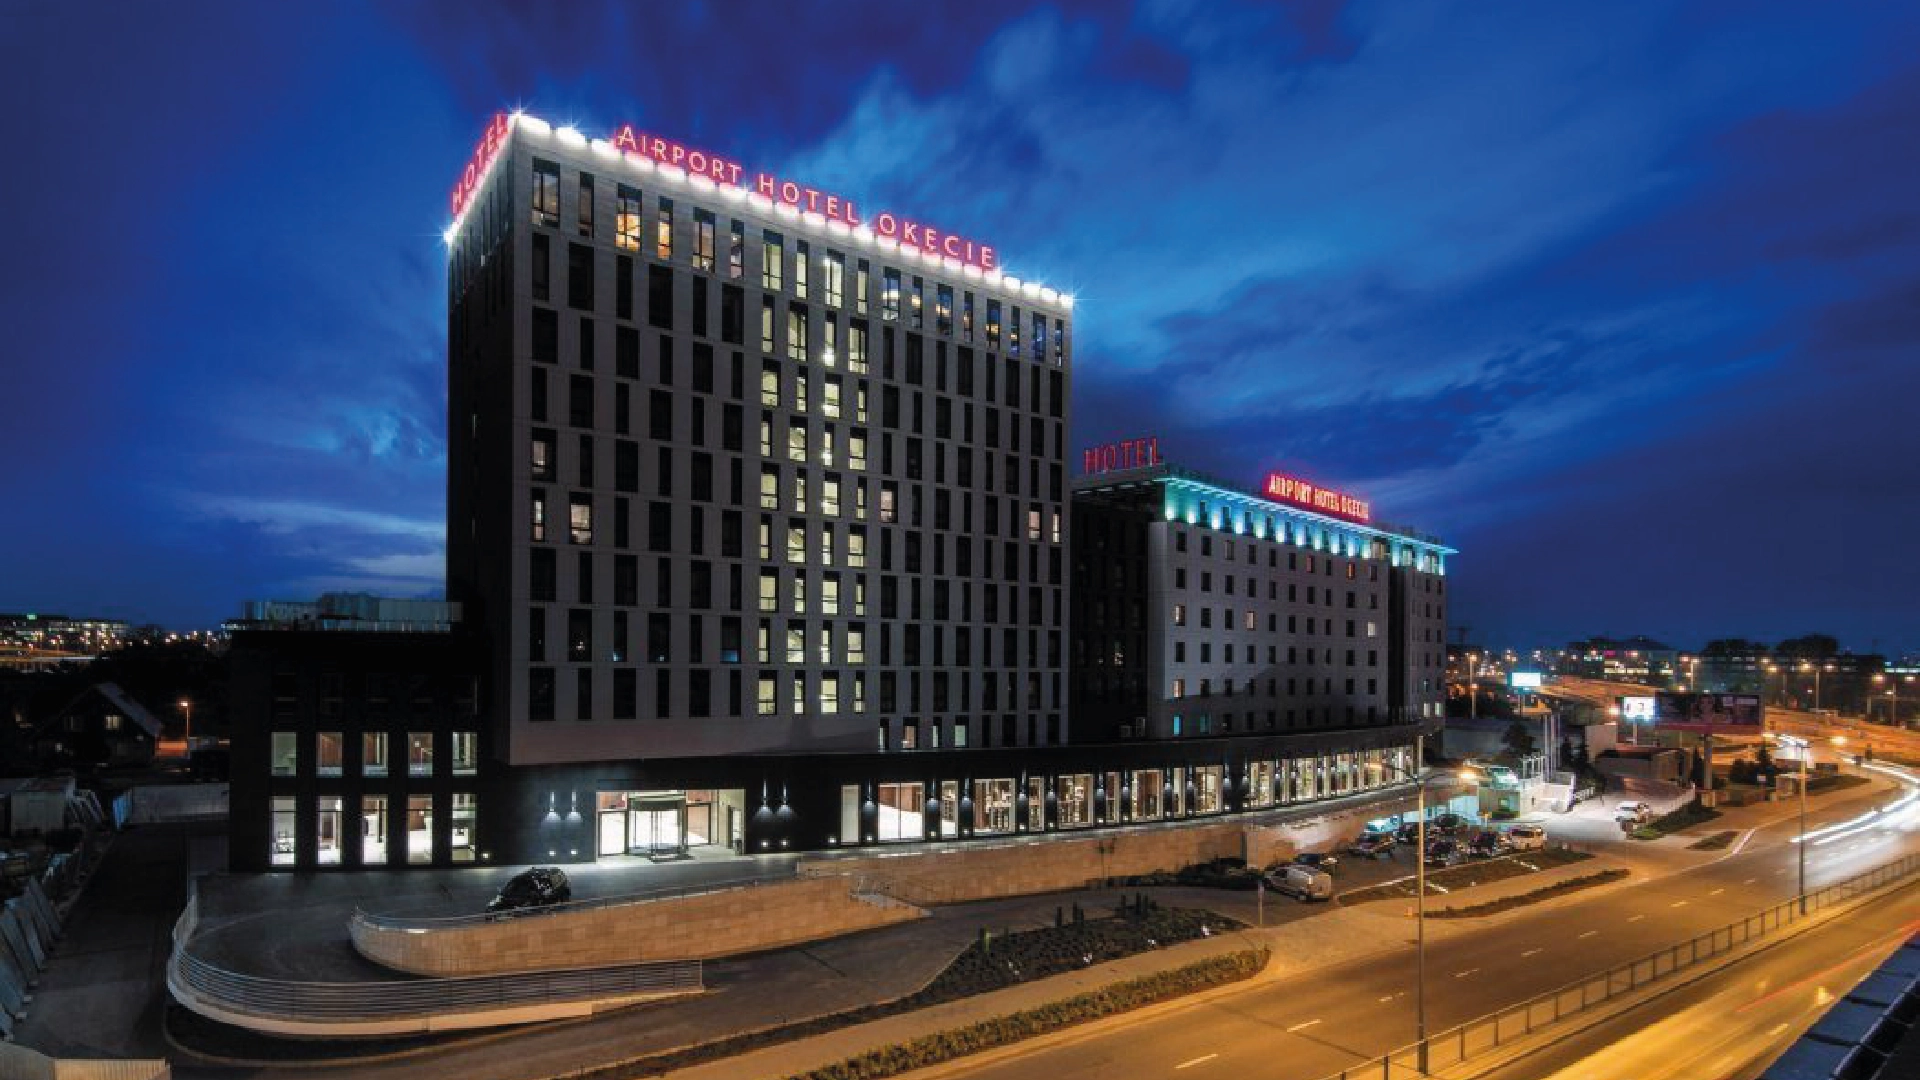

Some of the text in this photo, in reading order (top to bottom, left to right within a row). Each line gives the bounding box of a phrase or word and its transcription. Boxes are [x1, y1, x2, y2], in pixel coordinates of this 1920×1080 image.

[451, 111, 509, 215] HOTEL
[617, 124, 743, 184] AIRPORT
[757, 173, 859, 224] HOTEL
[1083, 438, 1163, 475] HOTEL
[1314, 487, 1340, 512] HOTEL
